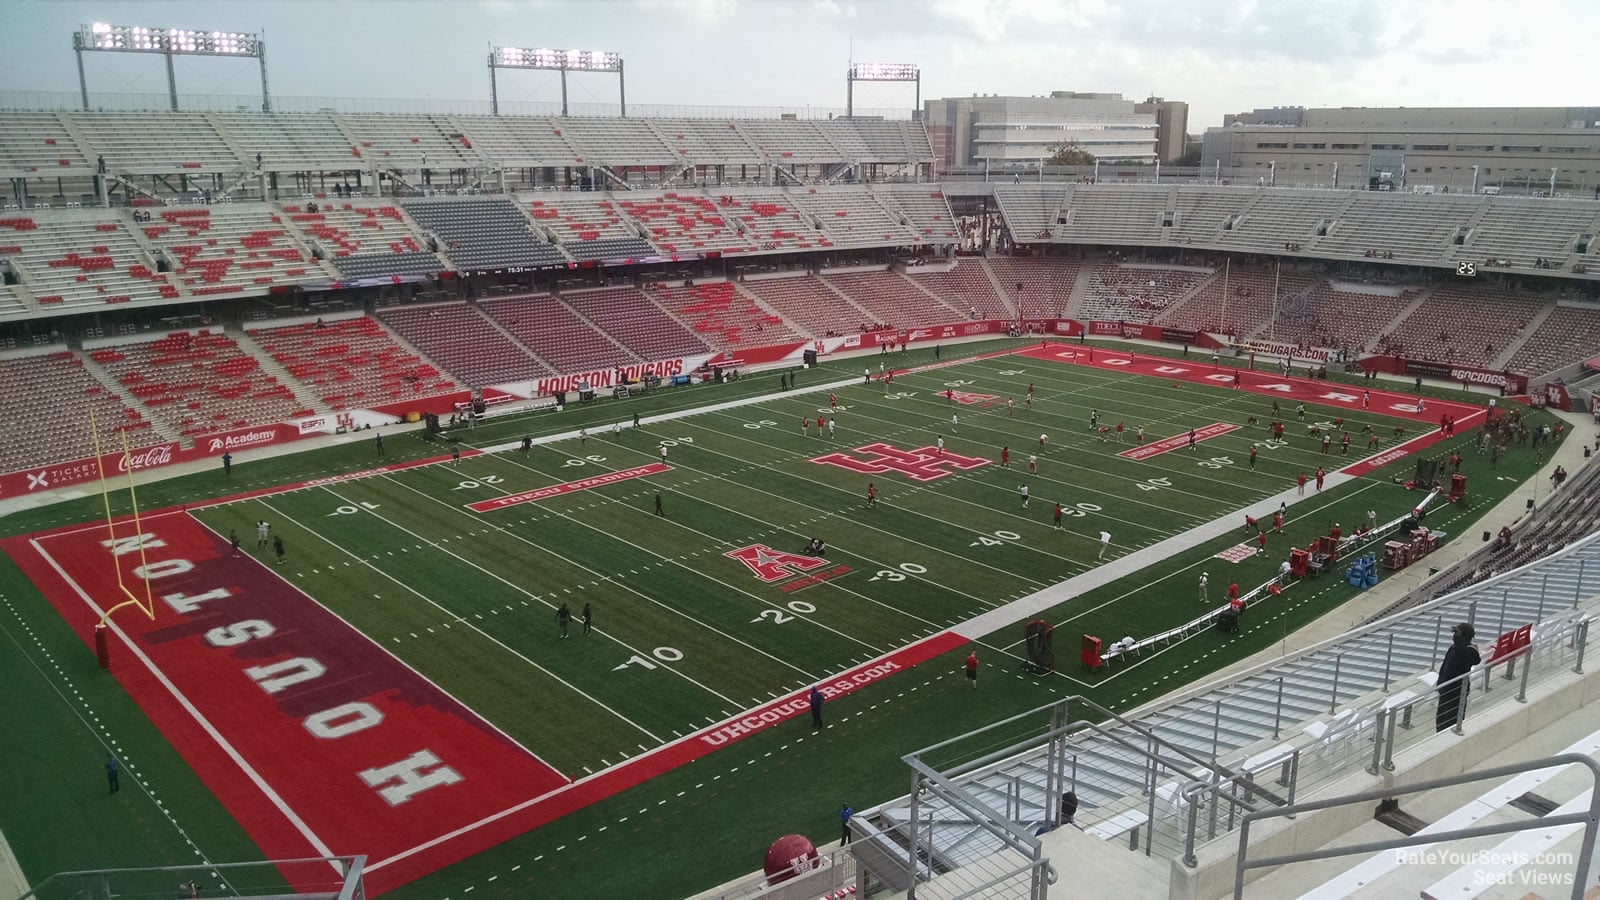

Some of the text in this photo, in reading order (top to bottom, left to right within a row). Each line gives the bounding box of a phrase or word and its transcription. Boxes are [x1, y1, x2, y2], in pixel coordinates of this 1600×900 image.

[1458, 262, 1474, 274] 25
[537, 358, 683, 397] HOUSTON COUGARS
[1056, 352, 1424, 413] COUGARS
[1451, 369, 1506, 387] #GOCOOGS
[301, 418, 325, 429] ESPN
[743, 419, 778, 430] 50
[225, 430, 276, 446] Academy
[660, 436, 694, 448] 40
[566, 454, 607, 467] 30
[1198, 457, 1234, 469] 30
[52, 463, 96, 477] TICKET
[53, 470, 97, 483] GALAXY
[458, 475, 505, 489] 20
[493, 467, 652, 506] TDECU STADIUM
[1136, 478, 1173, 493] 40
[336, 501, 380, 515] 10
[1060, 501, 1103, 518] 50
[977, 529, 1021, 548] 40
[877, 562, 928, 582] 30
[759, 600, 817, 625] 20
[627, 646, 684, 670] 10
[100, 532, 465, 808] HOUSTON
[700, 660, 902, 746] UHCOUGRS.COM
